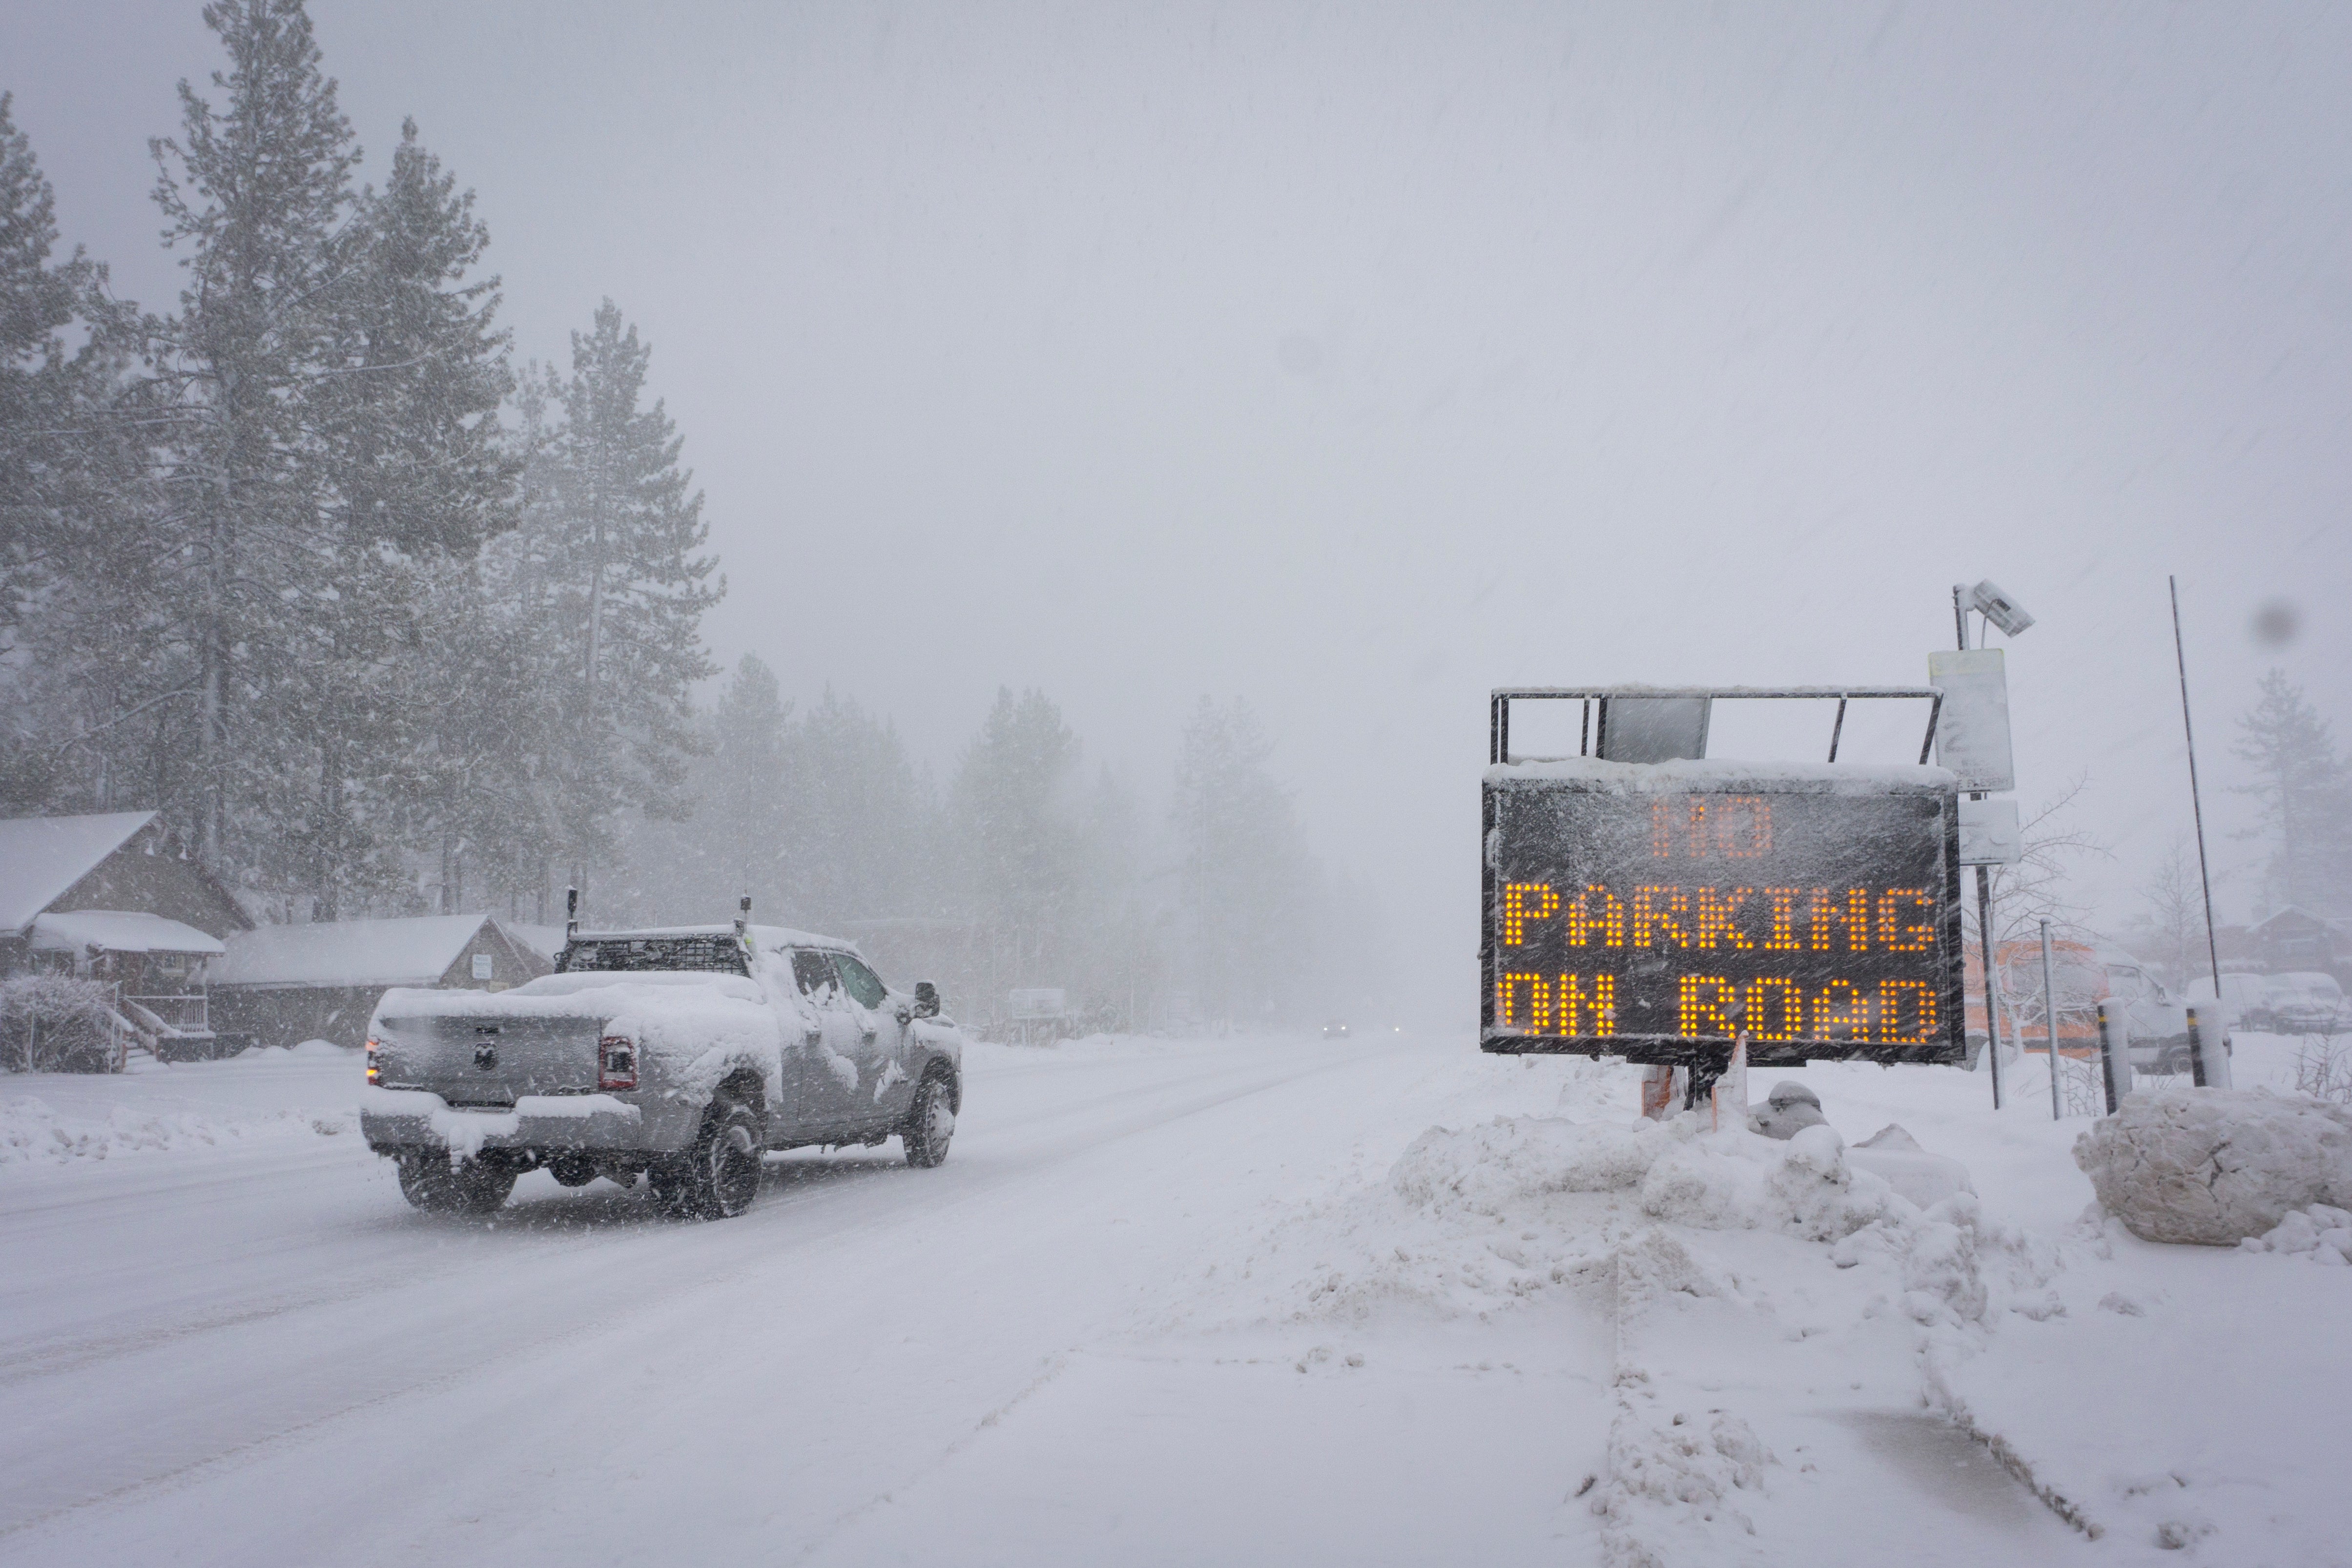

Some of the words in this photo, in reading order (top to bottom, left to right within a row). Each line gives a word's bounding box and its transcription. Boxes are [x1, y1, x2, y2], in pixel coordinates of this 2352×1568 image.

[1653, 797, 1772, 857] NO
[1505, 883, 1935, 951] PARKING
[1497, 972, 1614, 1037] ON
[1679, 976, 1937, 1044] ROAD
